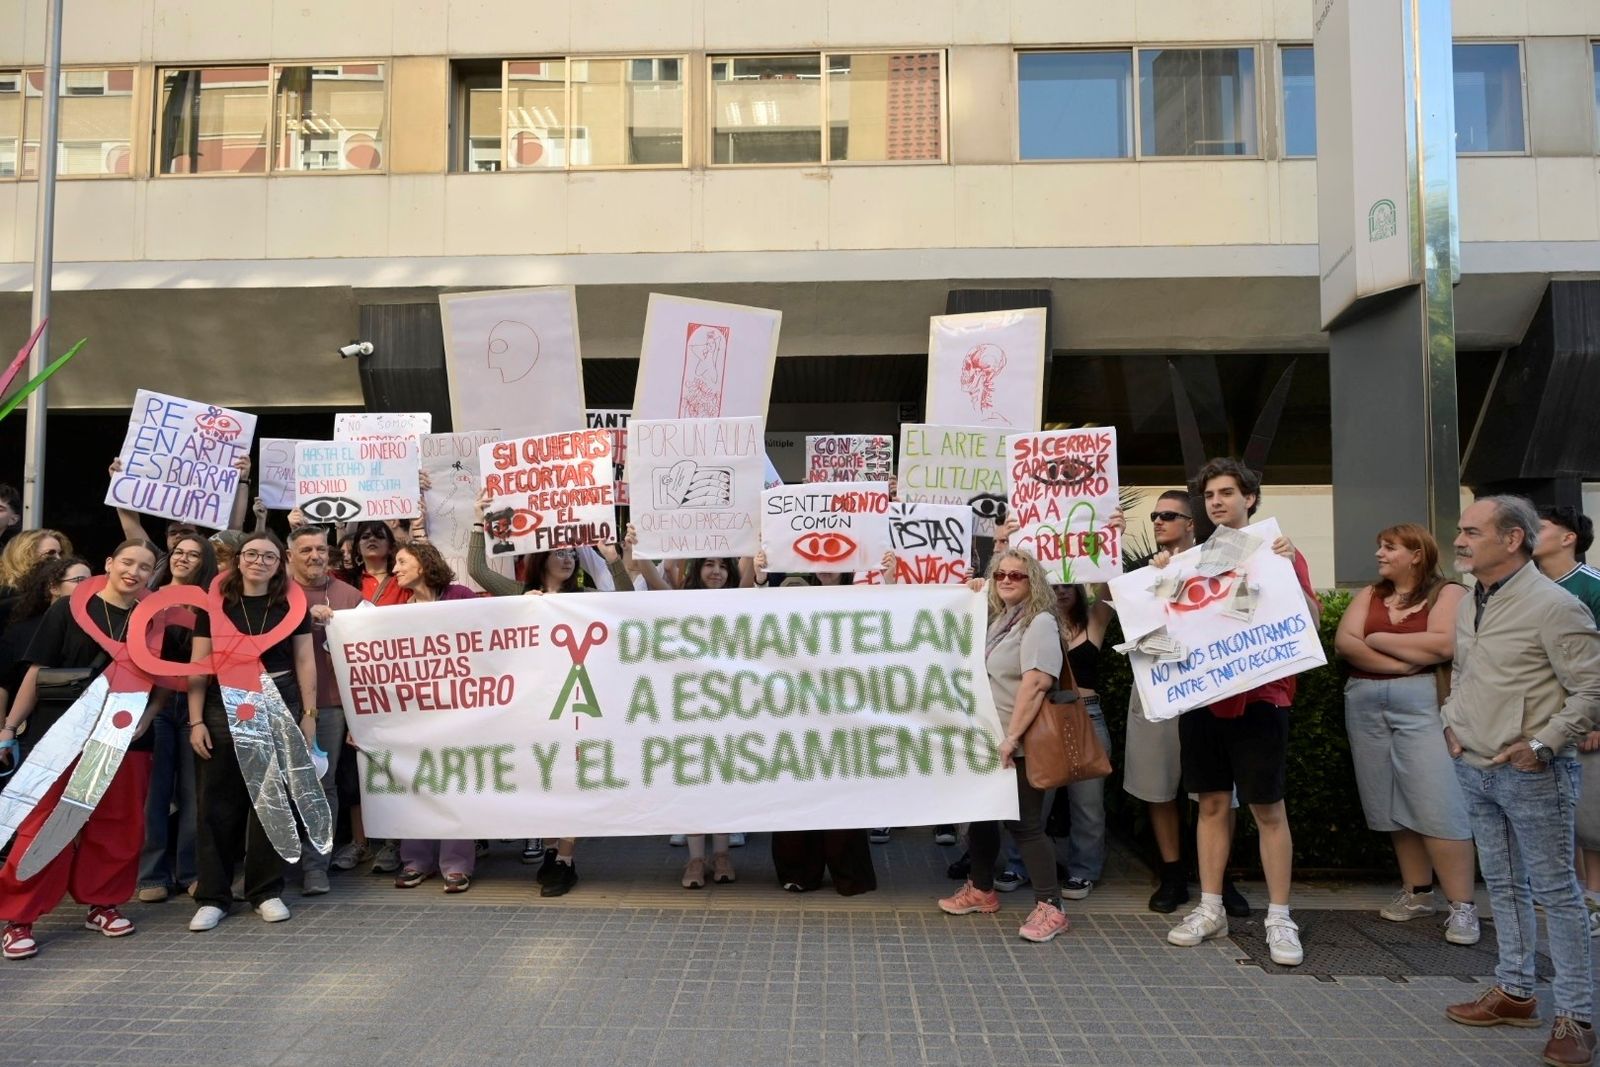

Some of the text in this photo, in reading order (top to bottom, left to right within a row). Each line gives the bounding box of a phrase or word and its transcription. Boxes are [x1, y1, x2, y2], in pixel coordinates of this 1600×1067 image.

[144, 398, 187, 430] RE
[135, 426, 178, 454] EN
[180, 435, 247, 468] ARTE
[303, 447, 337, 460] HASTA
[342, 447, 355, 460] EL
[360, 441, 407, 460] DINERO
[422, 437, 446, 458] QUE
[493, 442, 518, 470] SI
[522, 428, 611, 464] QUIERES
[637, 424, 679, 456] POR
[683, 424, 708, 456] UN
[714, 423, 757, 456] AULA
[767, 439, 794, 449] últiple
[814, 437, 851, 455] CON
[906, 430, 932, 456] EL
[940, 431, 988, 458] ARTE
[1013, 433, 1112, 460] SI CERRAIS
[126, 451, 238, 494] ES BORRAR
[297, 463, 320, 478] QUE
[322, 463, 334, 477] TE
[809, 469, 859, 482] NO HAY
[811, 453, 865, 470] RECORTE
[299, 479, 347, 495] BOLSILLO
[358, 479, 401, 493] NECESITA
[486, 462, 596, 498] RECORTAR
[906, 464, 1004, 492] CULTURA
[113, 477, 221, 523] CULTURA
[366, 495, 412, 517] DISEÑO
[1017, 503, 1041, 528] VA
[1044, 498, 1061, 521] A
[557, 508, 580, 524] EL
[640, 512, 753, 531] QUE NO PAREZCA
[790, 515, 852, 531] COMÚN
[660, 534, 731, 553] UNA LATA
[343, 625, 540, 664] ESCUELAS DE ARTE
[617, 608, 974, 665] DESMANTELAN
[1150, 662, 1170, 687] NO
[1177, 648, 1206, 675] NOS
[1208, 613, 1307, 661] ENCONTRAMOS
[349, 656, 471, 686] ANDALUZAS
[1167, 640, 1301, 704] ENTRE TANTO RECORTE
[351, 674, 515, 715] EN PELIGRO
[625, 664, 976, 725] A ESCONDIDAS
[412, 742, 518, 795] ARTE
[530, 741, 560, 792] Y
[575, 738, 630, 791] EL
[640, 724, 1001, 789] PENSAMIENTO
